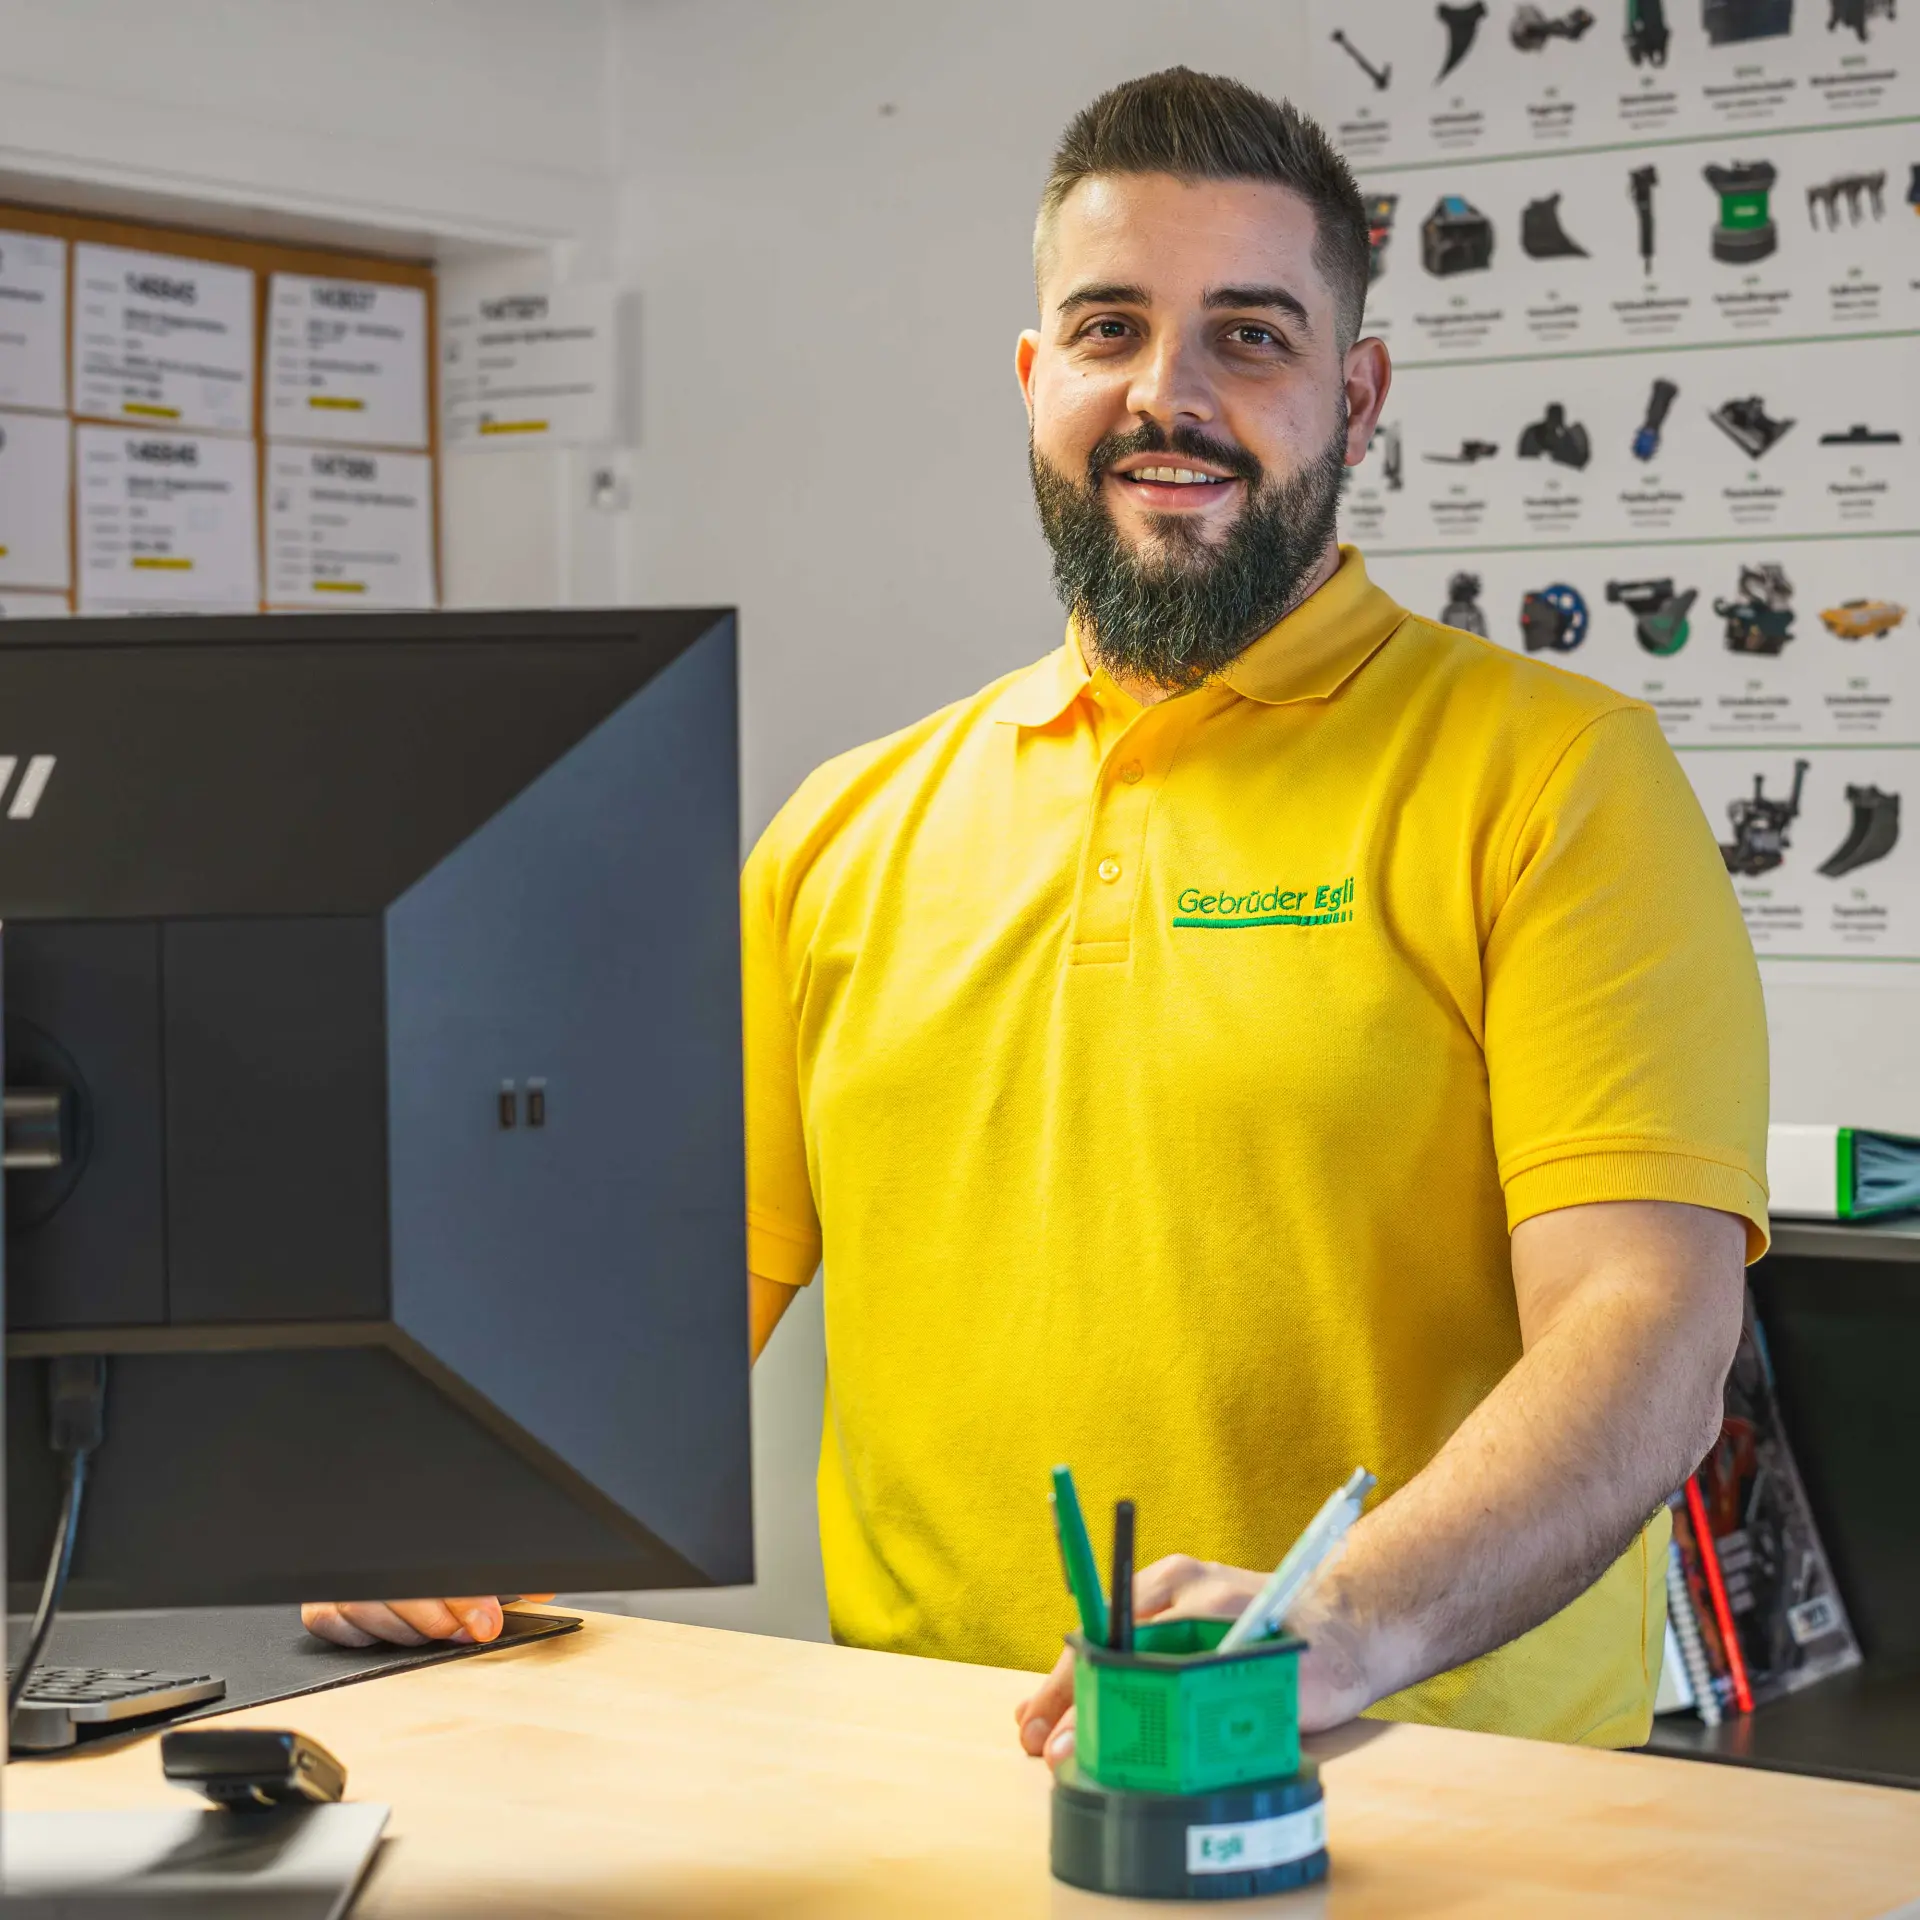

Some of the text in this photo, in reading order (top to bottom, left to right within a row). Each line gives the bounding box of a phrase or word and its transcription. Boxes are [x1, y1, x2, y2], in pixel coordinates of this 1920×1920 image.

[1177, 876, 1354, 914] Gebrüder Egli
[1202, 1836, 1242, 1861] Egli
